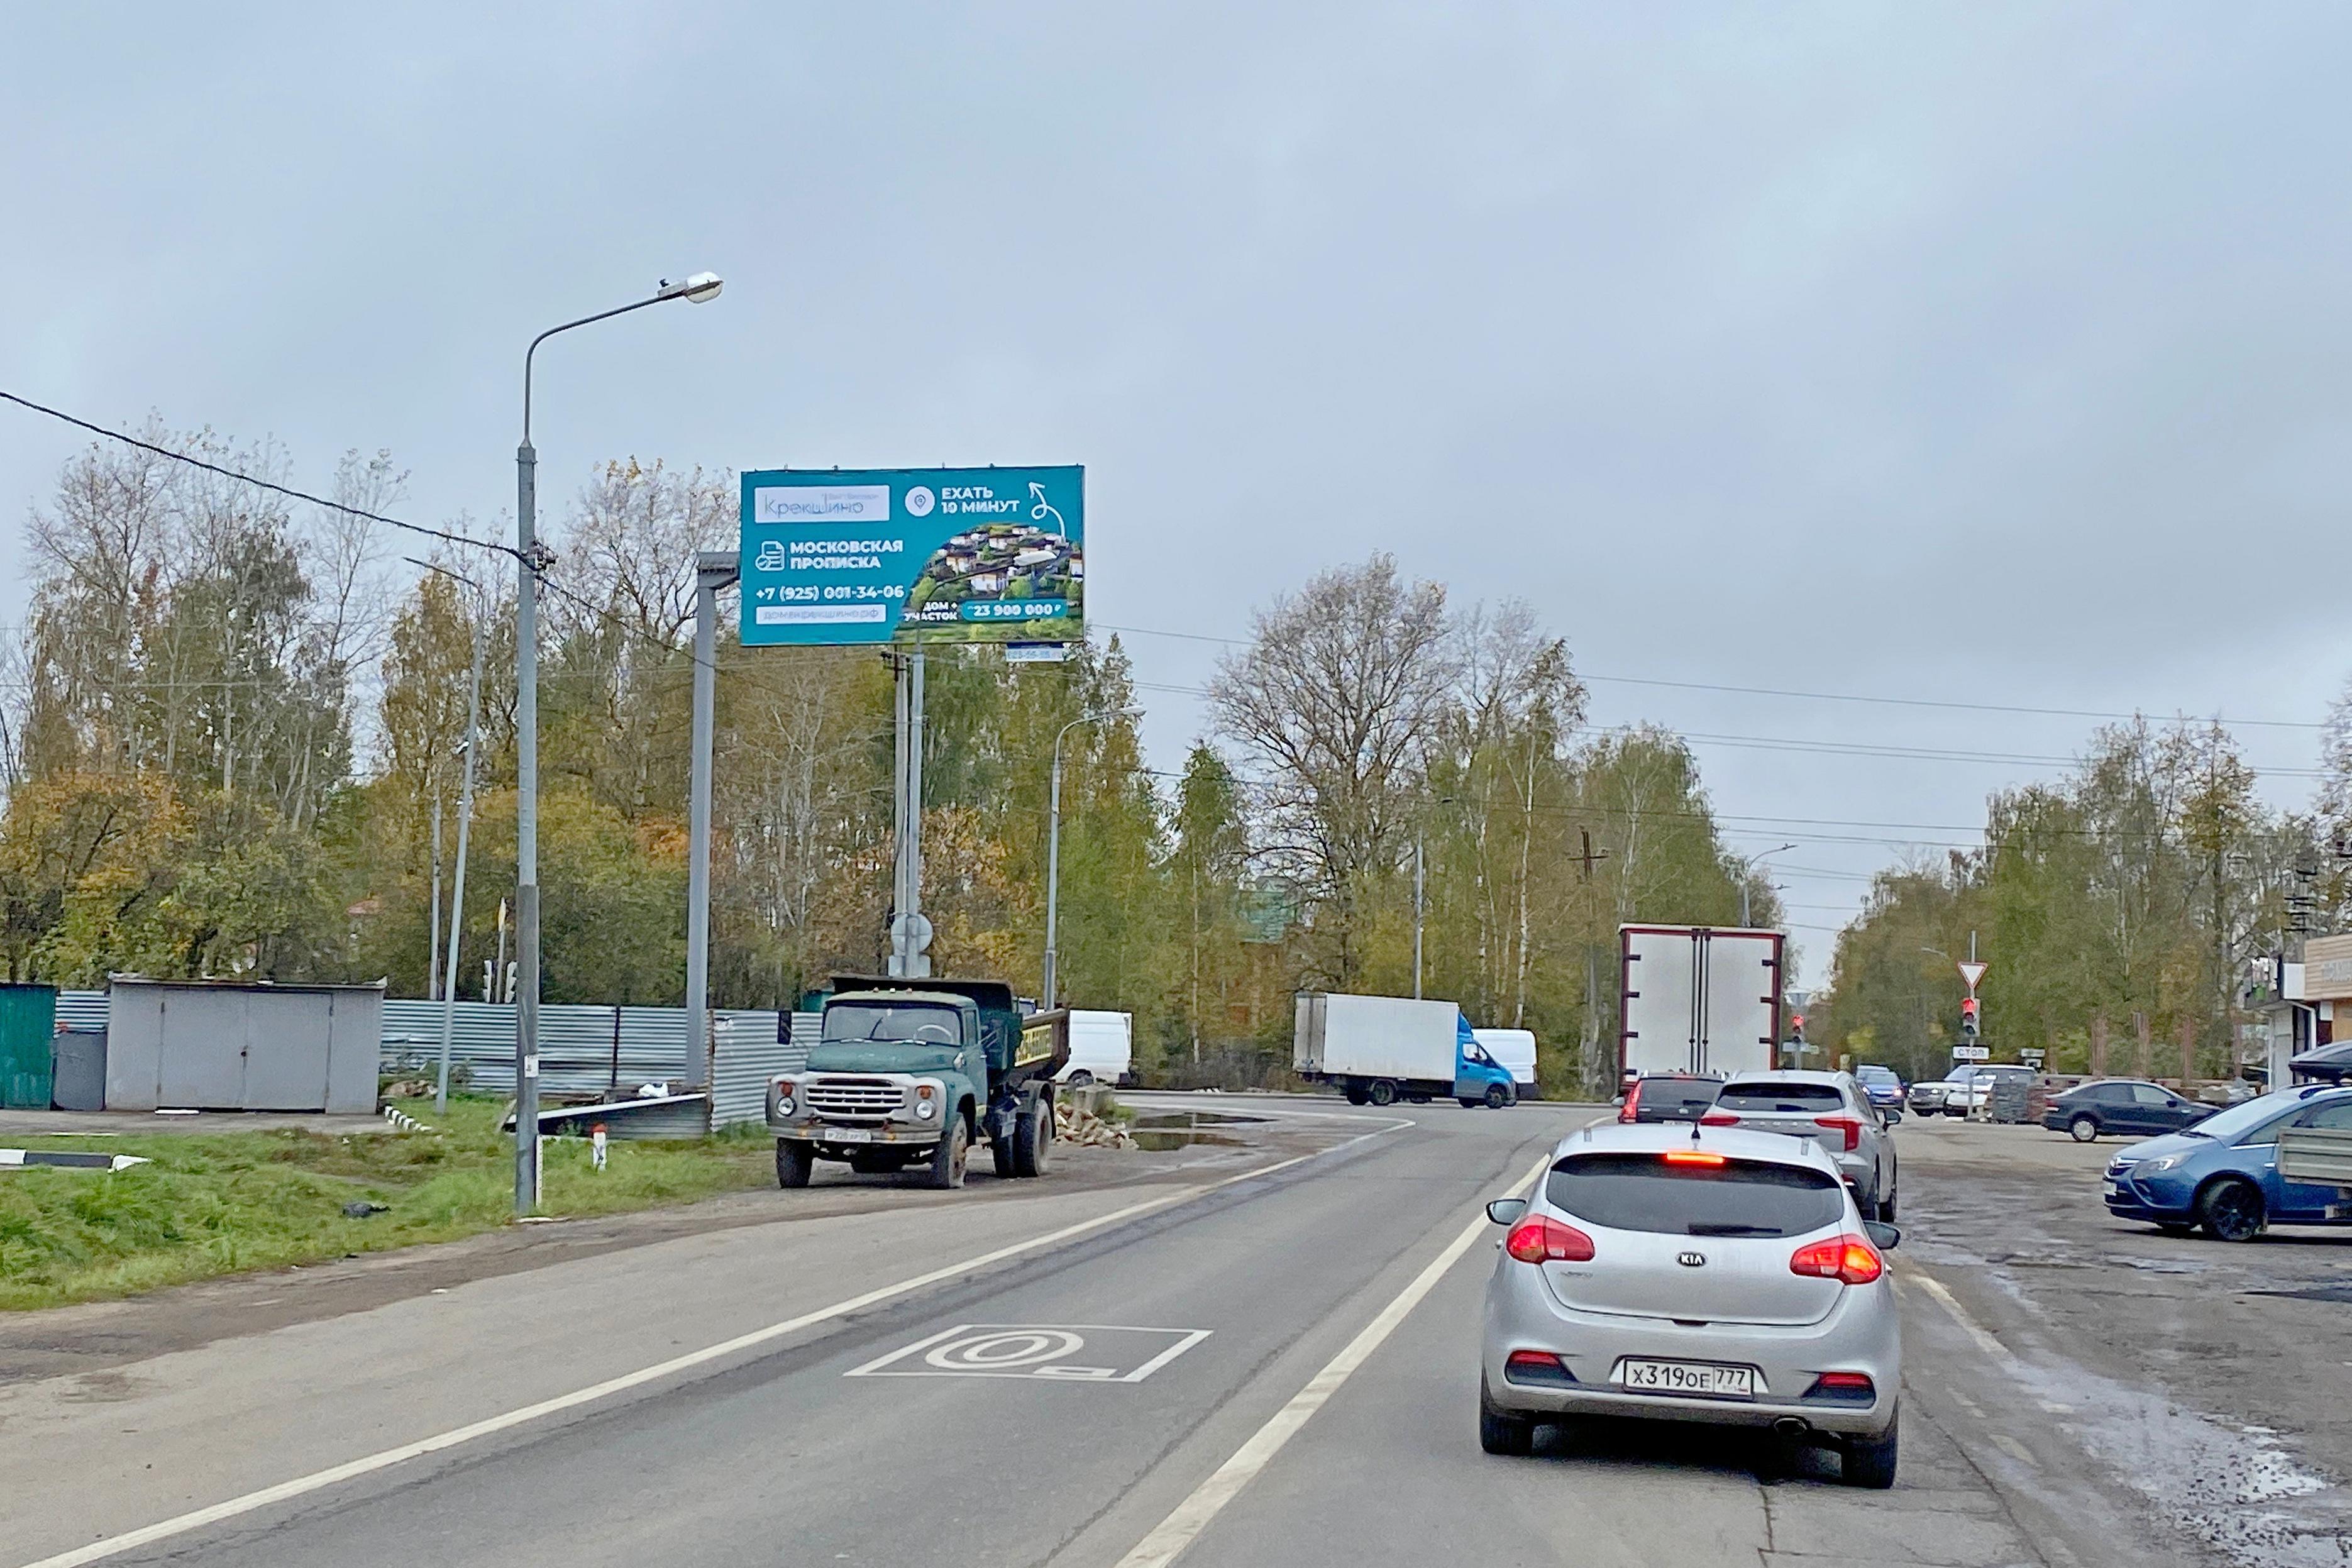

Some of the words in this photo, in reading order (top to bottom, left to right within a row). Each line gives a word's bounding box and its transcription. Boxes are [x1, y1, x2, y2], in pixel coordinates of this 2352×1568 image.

[941, 487, 993, 500] ЕХАТЬ
[941, 502, 958, 514] 10
[961, 500, 1020, 513] МИНУТ
[790, 540, 903, 554] МОСКОВСКАЯ
[790, 556, 881, 569] ПРОПИСКА
[756, 587, 775, 599] +7
[780, 585, 819, 601] (925)
[824, 585, 905, 599] 001-34-06
[923, 602, 949, 611] ДОМ
[974, 605, 990, 616] 23
[904, 612, 958, 622] УЧАСТОК
[1681, 1253, 1703, 1264] KIA
